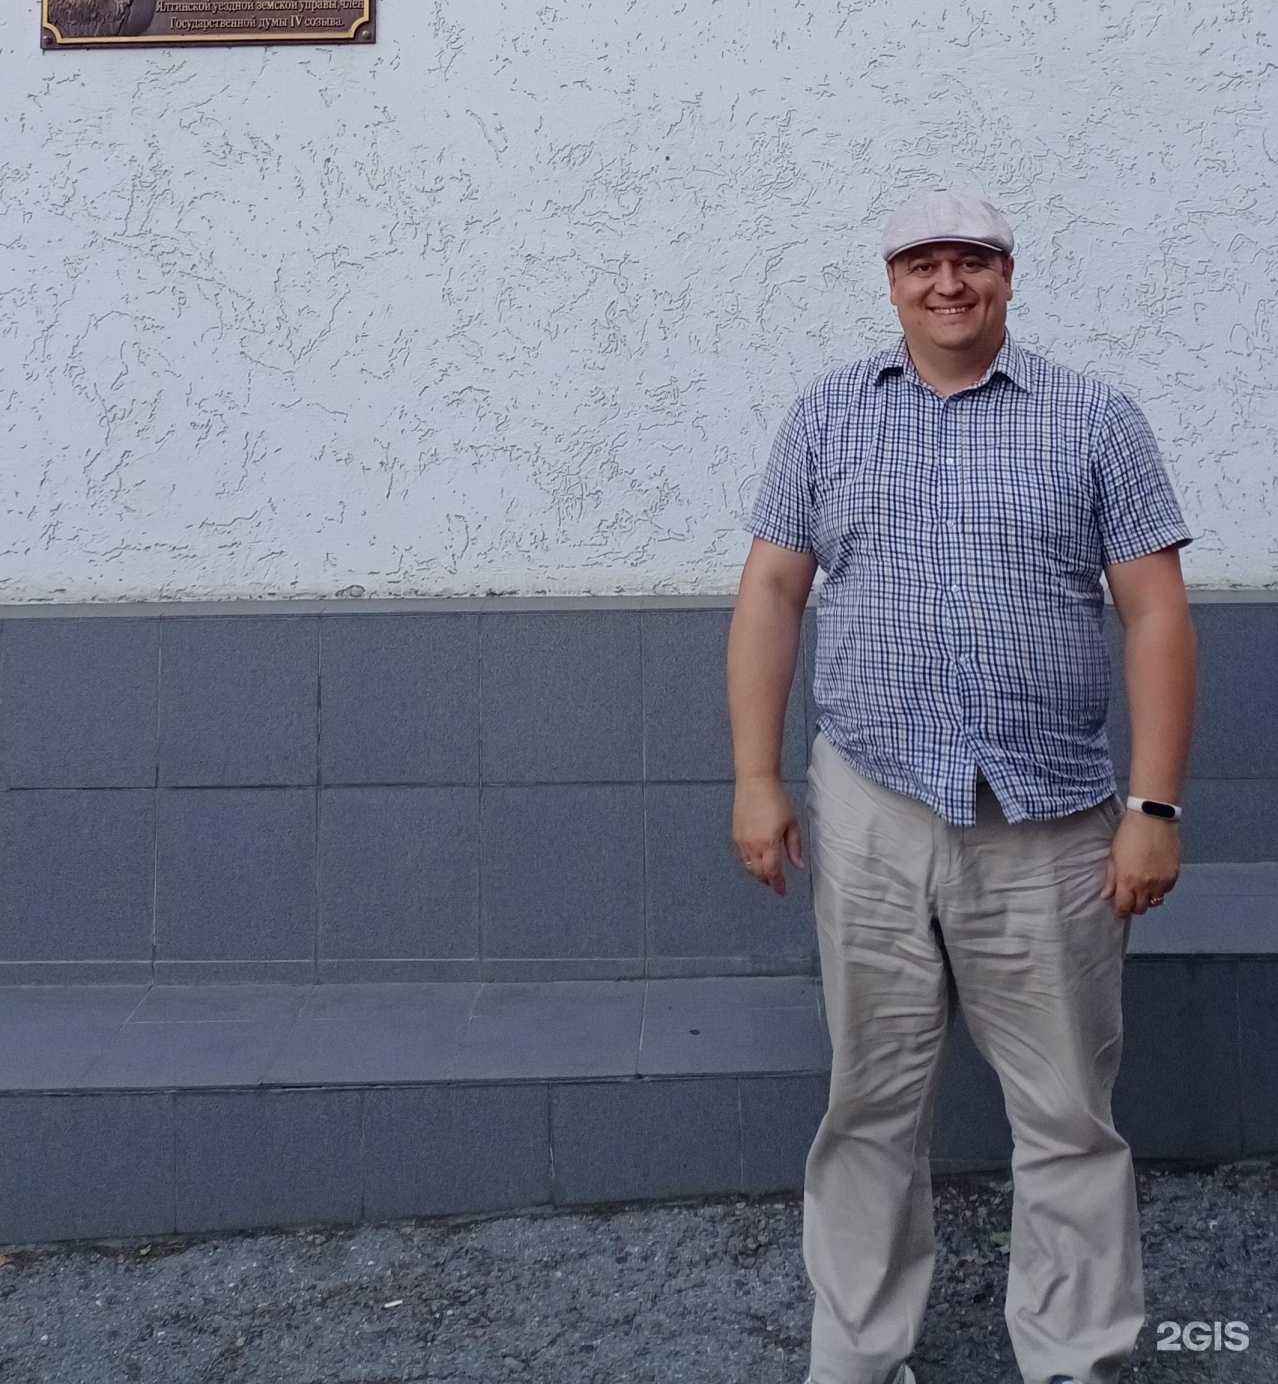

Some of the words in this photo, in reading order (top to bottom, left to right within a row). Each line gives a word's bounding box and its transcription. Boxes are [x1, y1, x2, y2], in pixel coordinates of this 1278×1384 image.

[156, 0, 211, 14] Ялтинской
[256, 0, 300, 12] земской
[169, 16, 257, 31] Государственной
[258, 16, 288, 30] думы
[290, 16, 303, 29] IV
